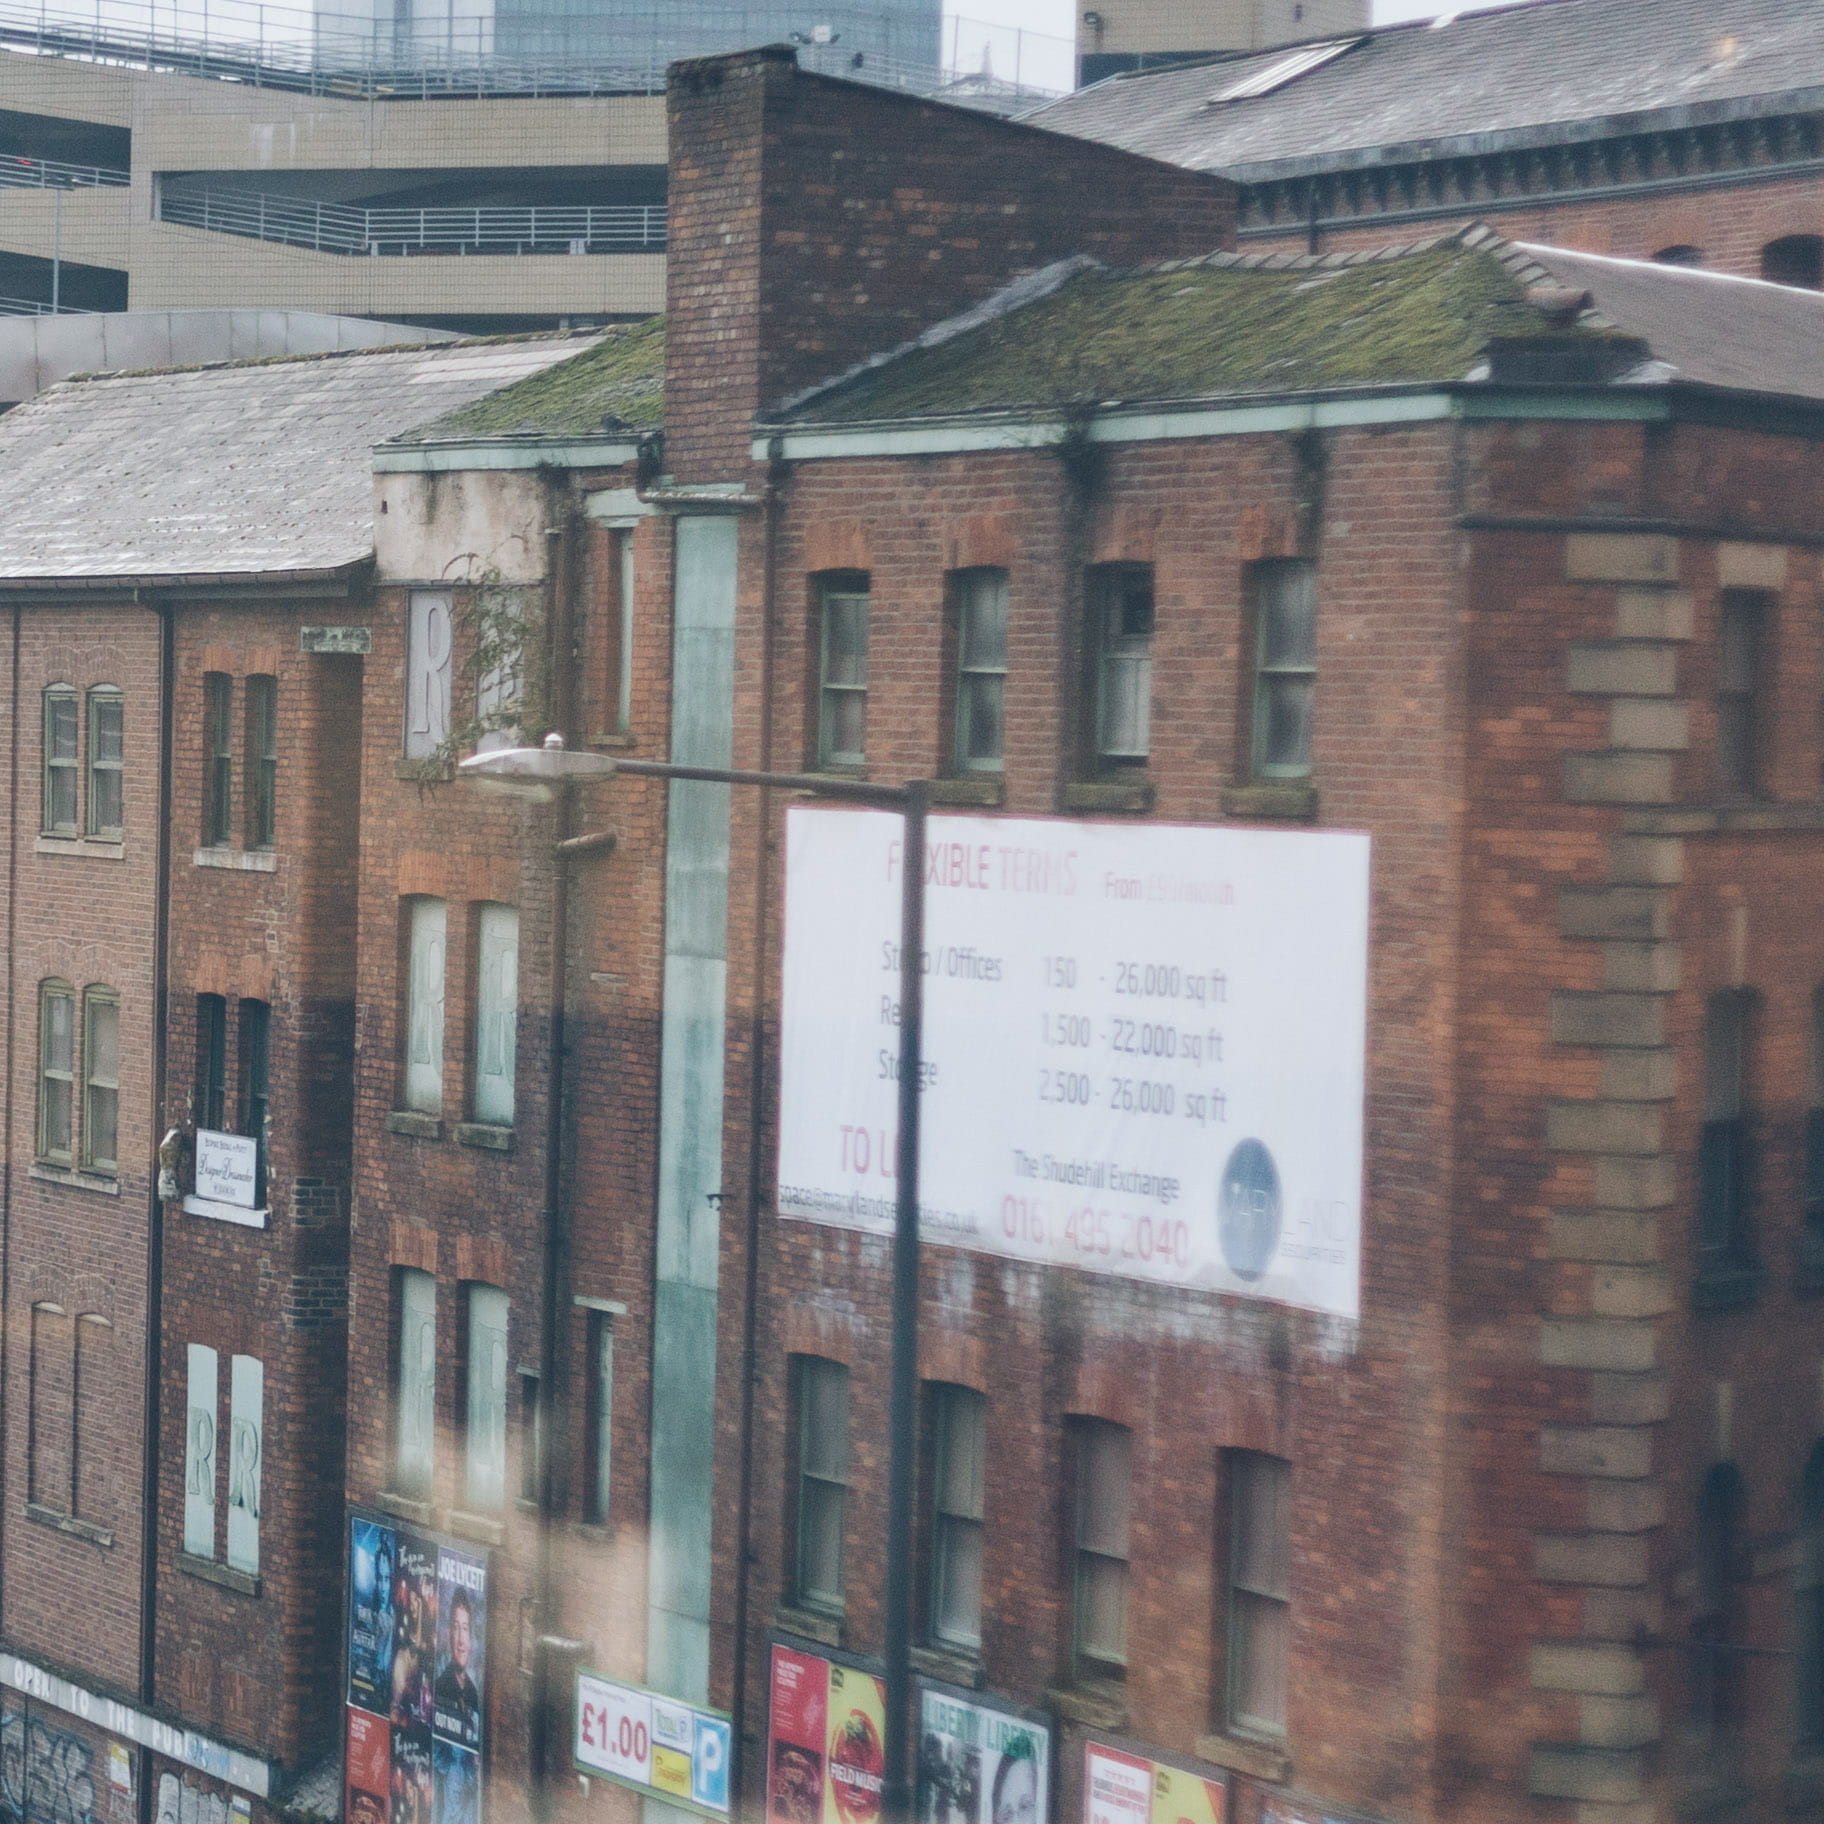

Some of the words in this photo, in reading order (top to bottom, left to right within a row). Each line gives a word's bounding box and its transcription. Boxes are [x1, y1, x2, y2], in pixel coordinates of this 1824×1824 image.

[887, 840, 991, 890] FXIBLE
[997, 847, 1078, 896] TERMS
[948, 946, 1004, 982] Offices
[1044, 955, 1077, 989] 150
[1115, 961, 1180, 1000] 26,000
[1186, 973, 1206, 1009] sq
[1211, 968, 1227, 1004] ft
[1041, 1012, 1091, 1048] 1,500
[1113, 1018, 1177, 1059] 22,000
[1181, 1033, 1202, 1068] sq
[1207, 1028, 1225, 1063] ft
[1110, 1077, 1176, 1117] 26,000
[1185, 1093, 1206, 1129] sq
[1211, 1087, 1228, 1123] ft
[840, 1125, 870, 1175] TO
[1013, 1148, 1038, 1179] The
[1110, 1163, 1181, 1205] Exchange
[439, 1555, 457, 1582] JOE
[14, 1660, 52, 1699] OPEN
[71, 1685, 90, 1718] TO
[108, 1697, 136, 1736] THE
[582, 1702, 648, 1764] £1.00
[700, 1727, 722, 1794] P
